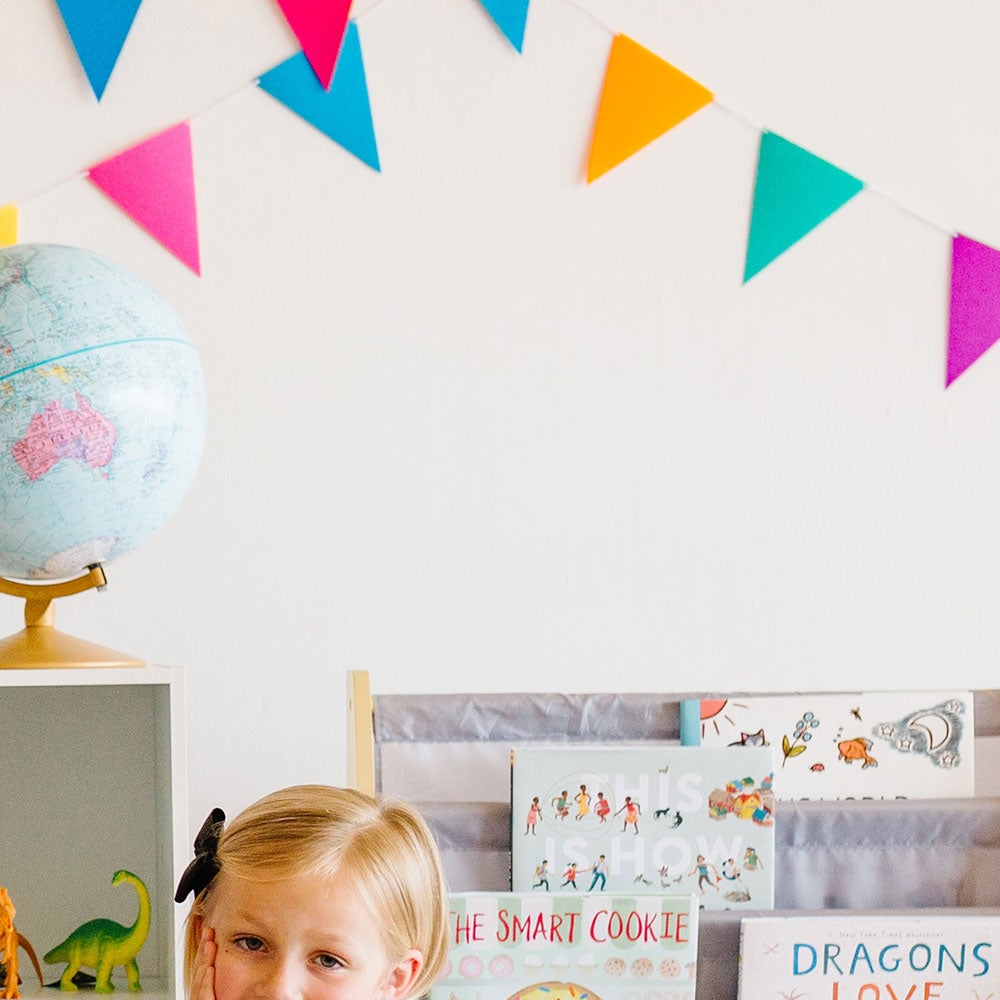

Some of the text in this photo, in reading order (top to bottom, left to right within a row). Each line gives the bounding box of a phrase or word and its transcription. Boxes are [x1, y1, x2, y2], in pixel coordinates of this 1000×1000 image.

[578, 773, 704, 813] THIS
[545, 836, 743, 877] IS HOW
[449, 909, 690, 944] HE SMART COOKIE
[793, 943, 993, 977] DRAGONS
